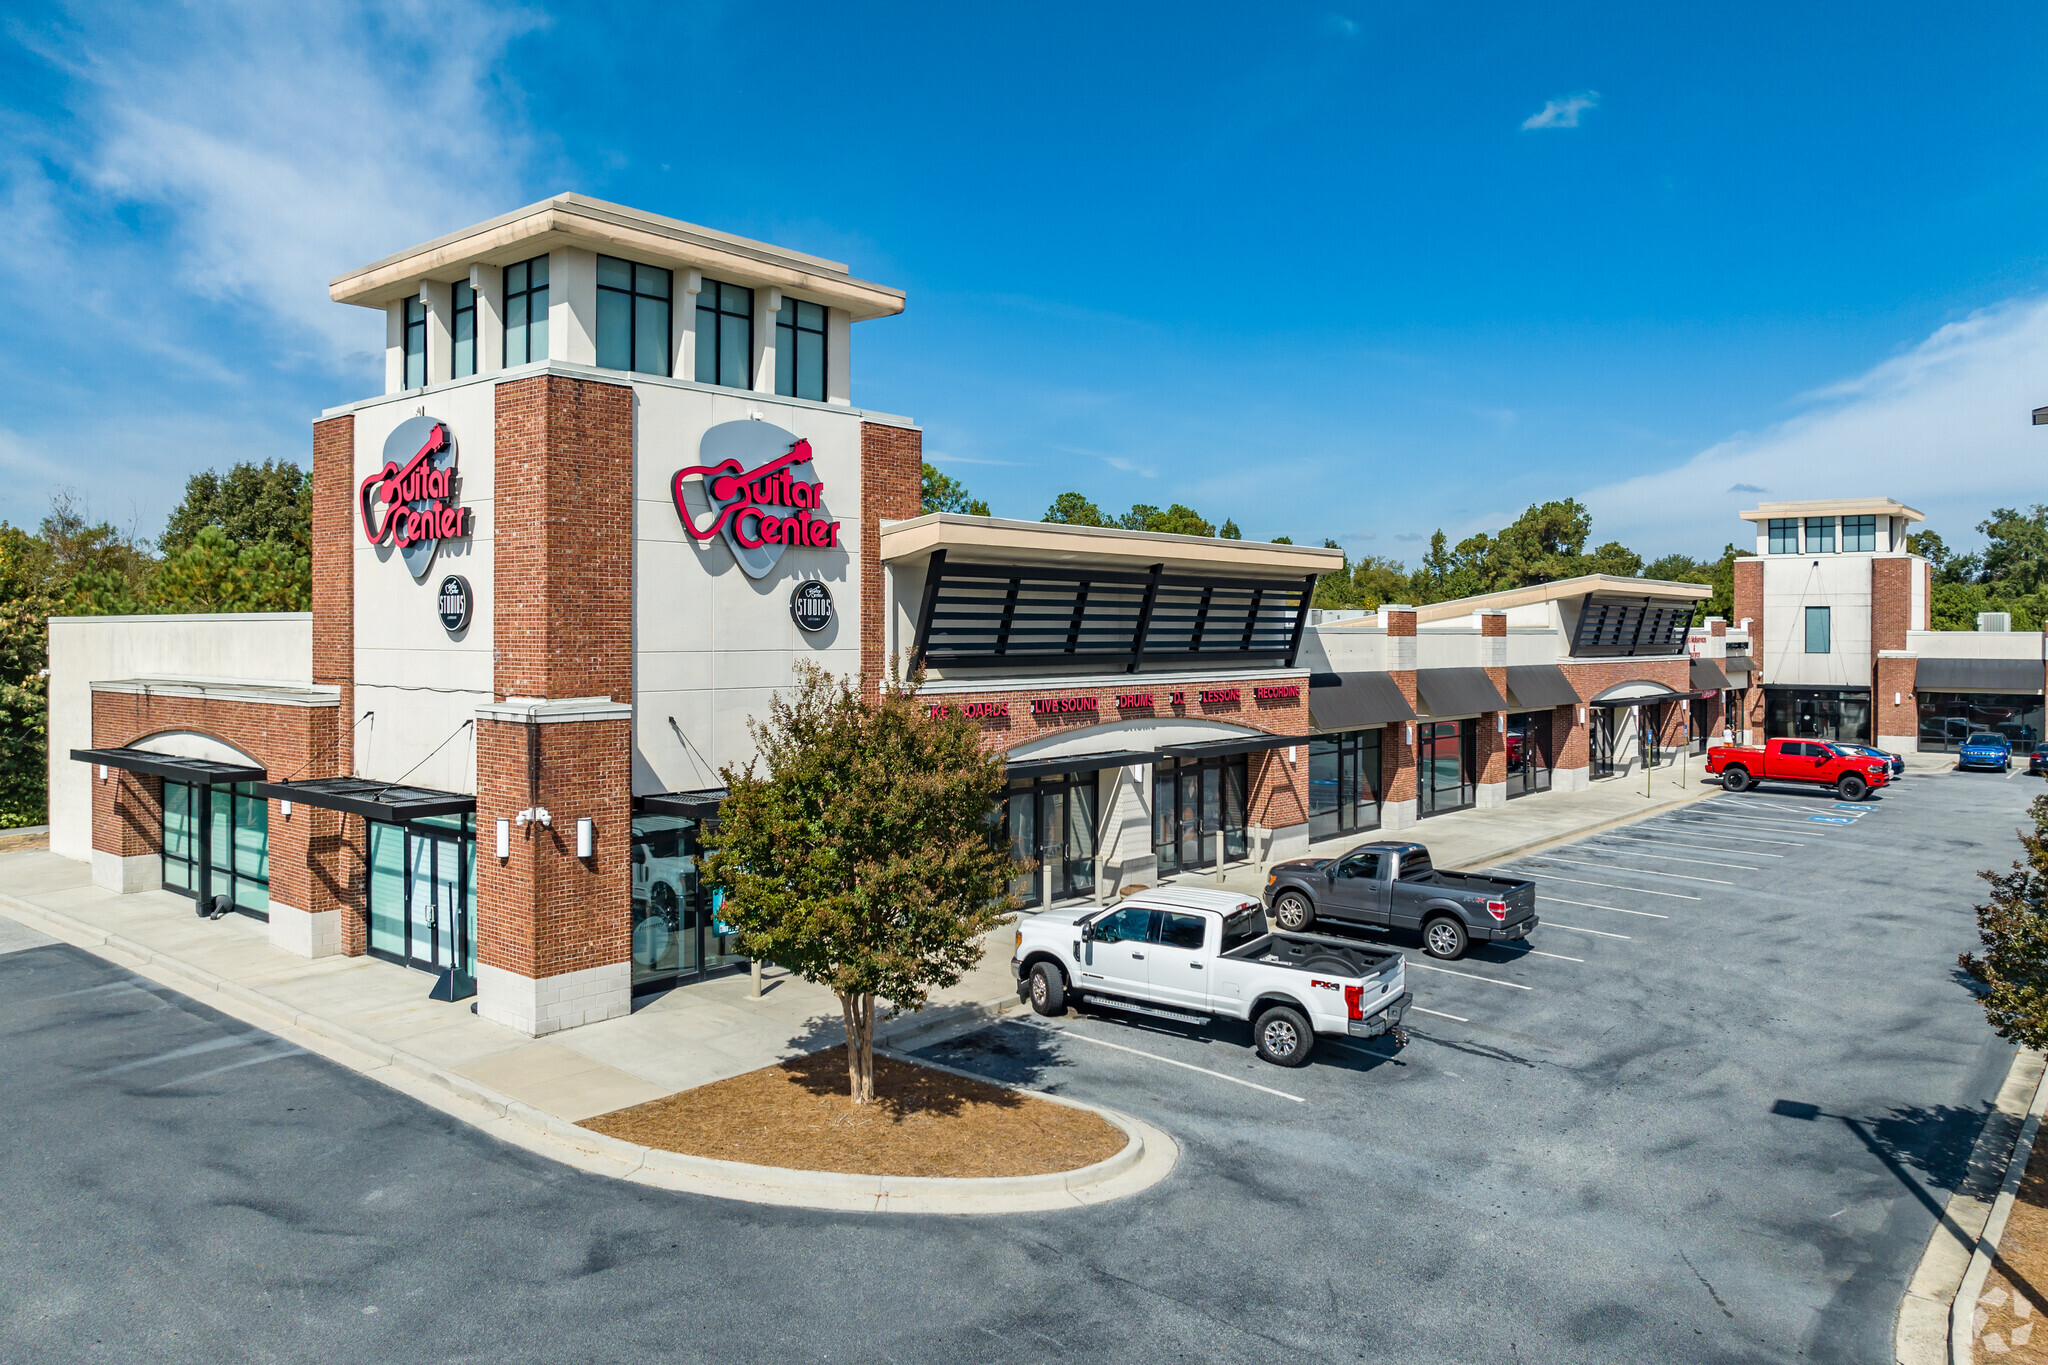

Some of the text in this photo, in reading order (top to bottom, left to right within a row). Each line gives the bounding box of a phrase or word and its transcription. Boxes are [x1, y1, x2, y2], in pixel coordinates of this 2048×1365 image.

[360, 423, 452, 545] Guitar
[674, 438, 823, 540] Guitar
[392, 500, 465, 548] Center
[735, 510, 840, 549] Center
[798, 598, 831, 616] STUDIOS
[1120, 694, 1154, 708] DRUMS
[1173, 692, 1185, 704] DJ
[1202, 689, 1241, 703] LESSONS
[1257, 685, 1300, 699] RECORDING
[931, 702, 1008, 720] KEBOARDS
[1035, 697, 1098, 714] LIVE SOUND
